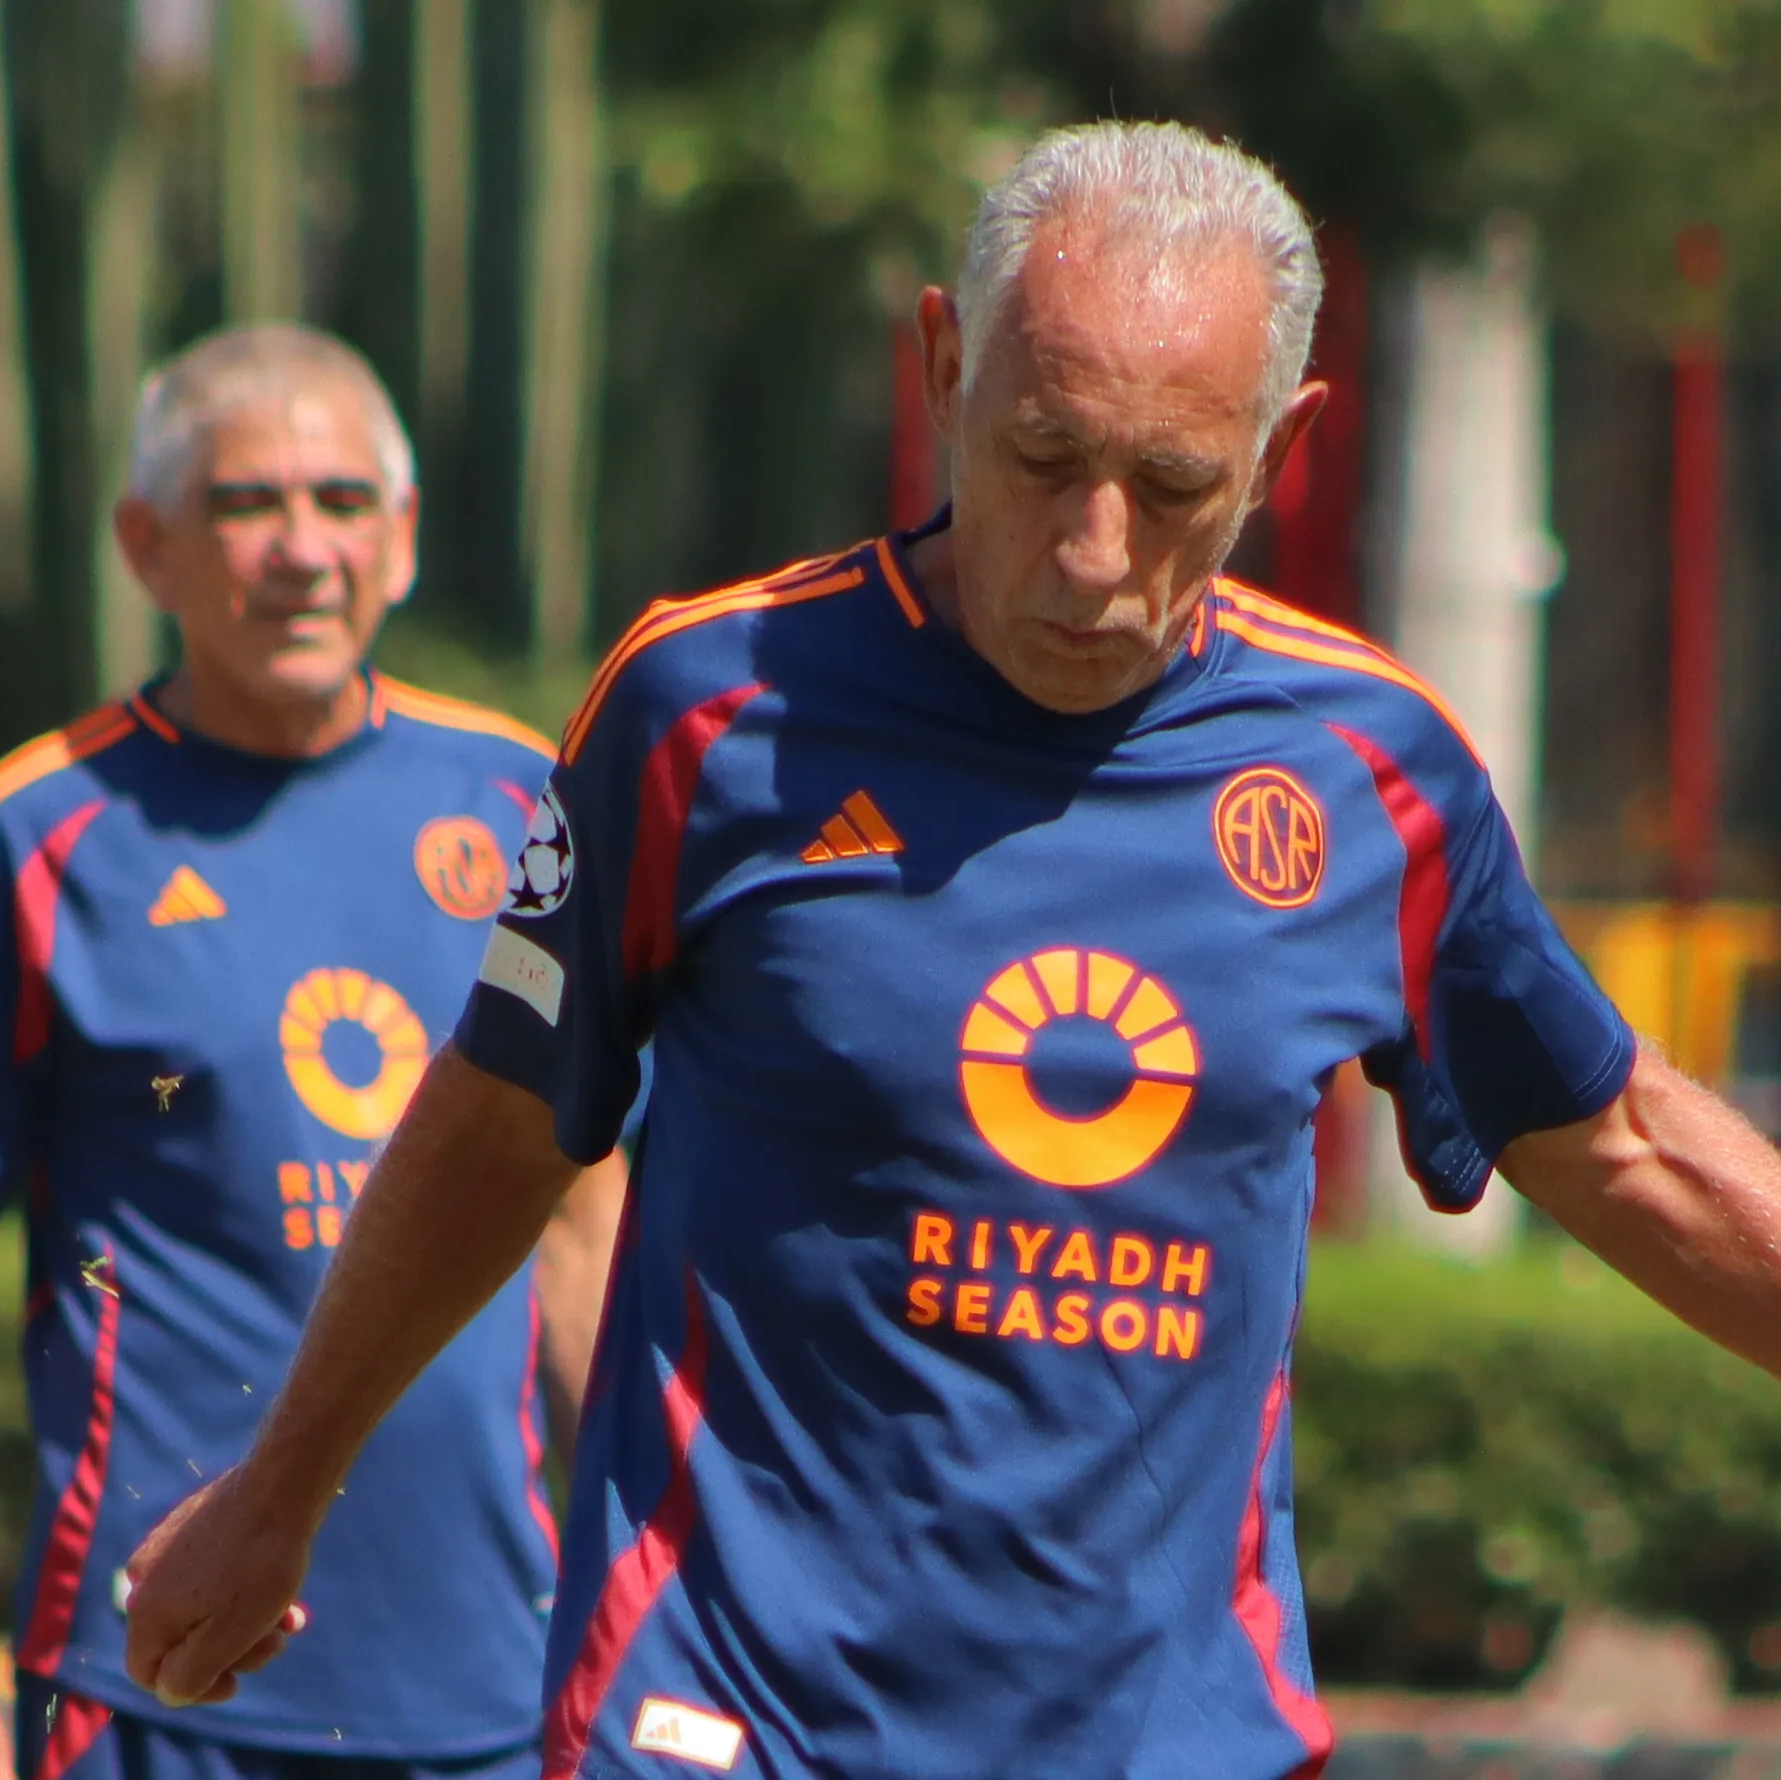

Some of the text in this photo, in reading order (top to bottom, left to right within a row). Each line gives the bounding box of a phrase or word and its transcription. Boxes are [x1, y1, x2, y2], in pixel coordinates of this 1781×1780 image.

[1223, 784, 1318, 892] ASR
[277, 1160, 370, 1204] RIY
[911, 1213, 1207, 1297] RIYADH
[905, 1278, 1199, 1360] SEASON
